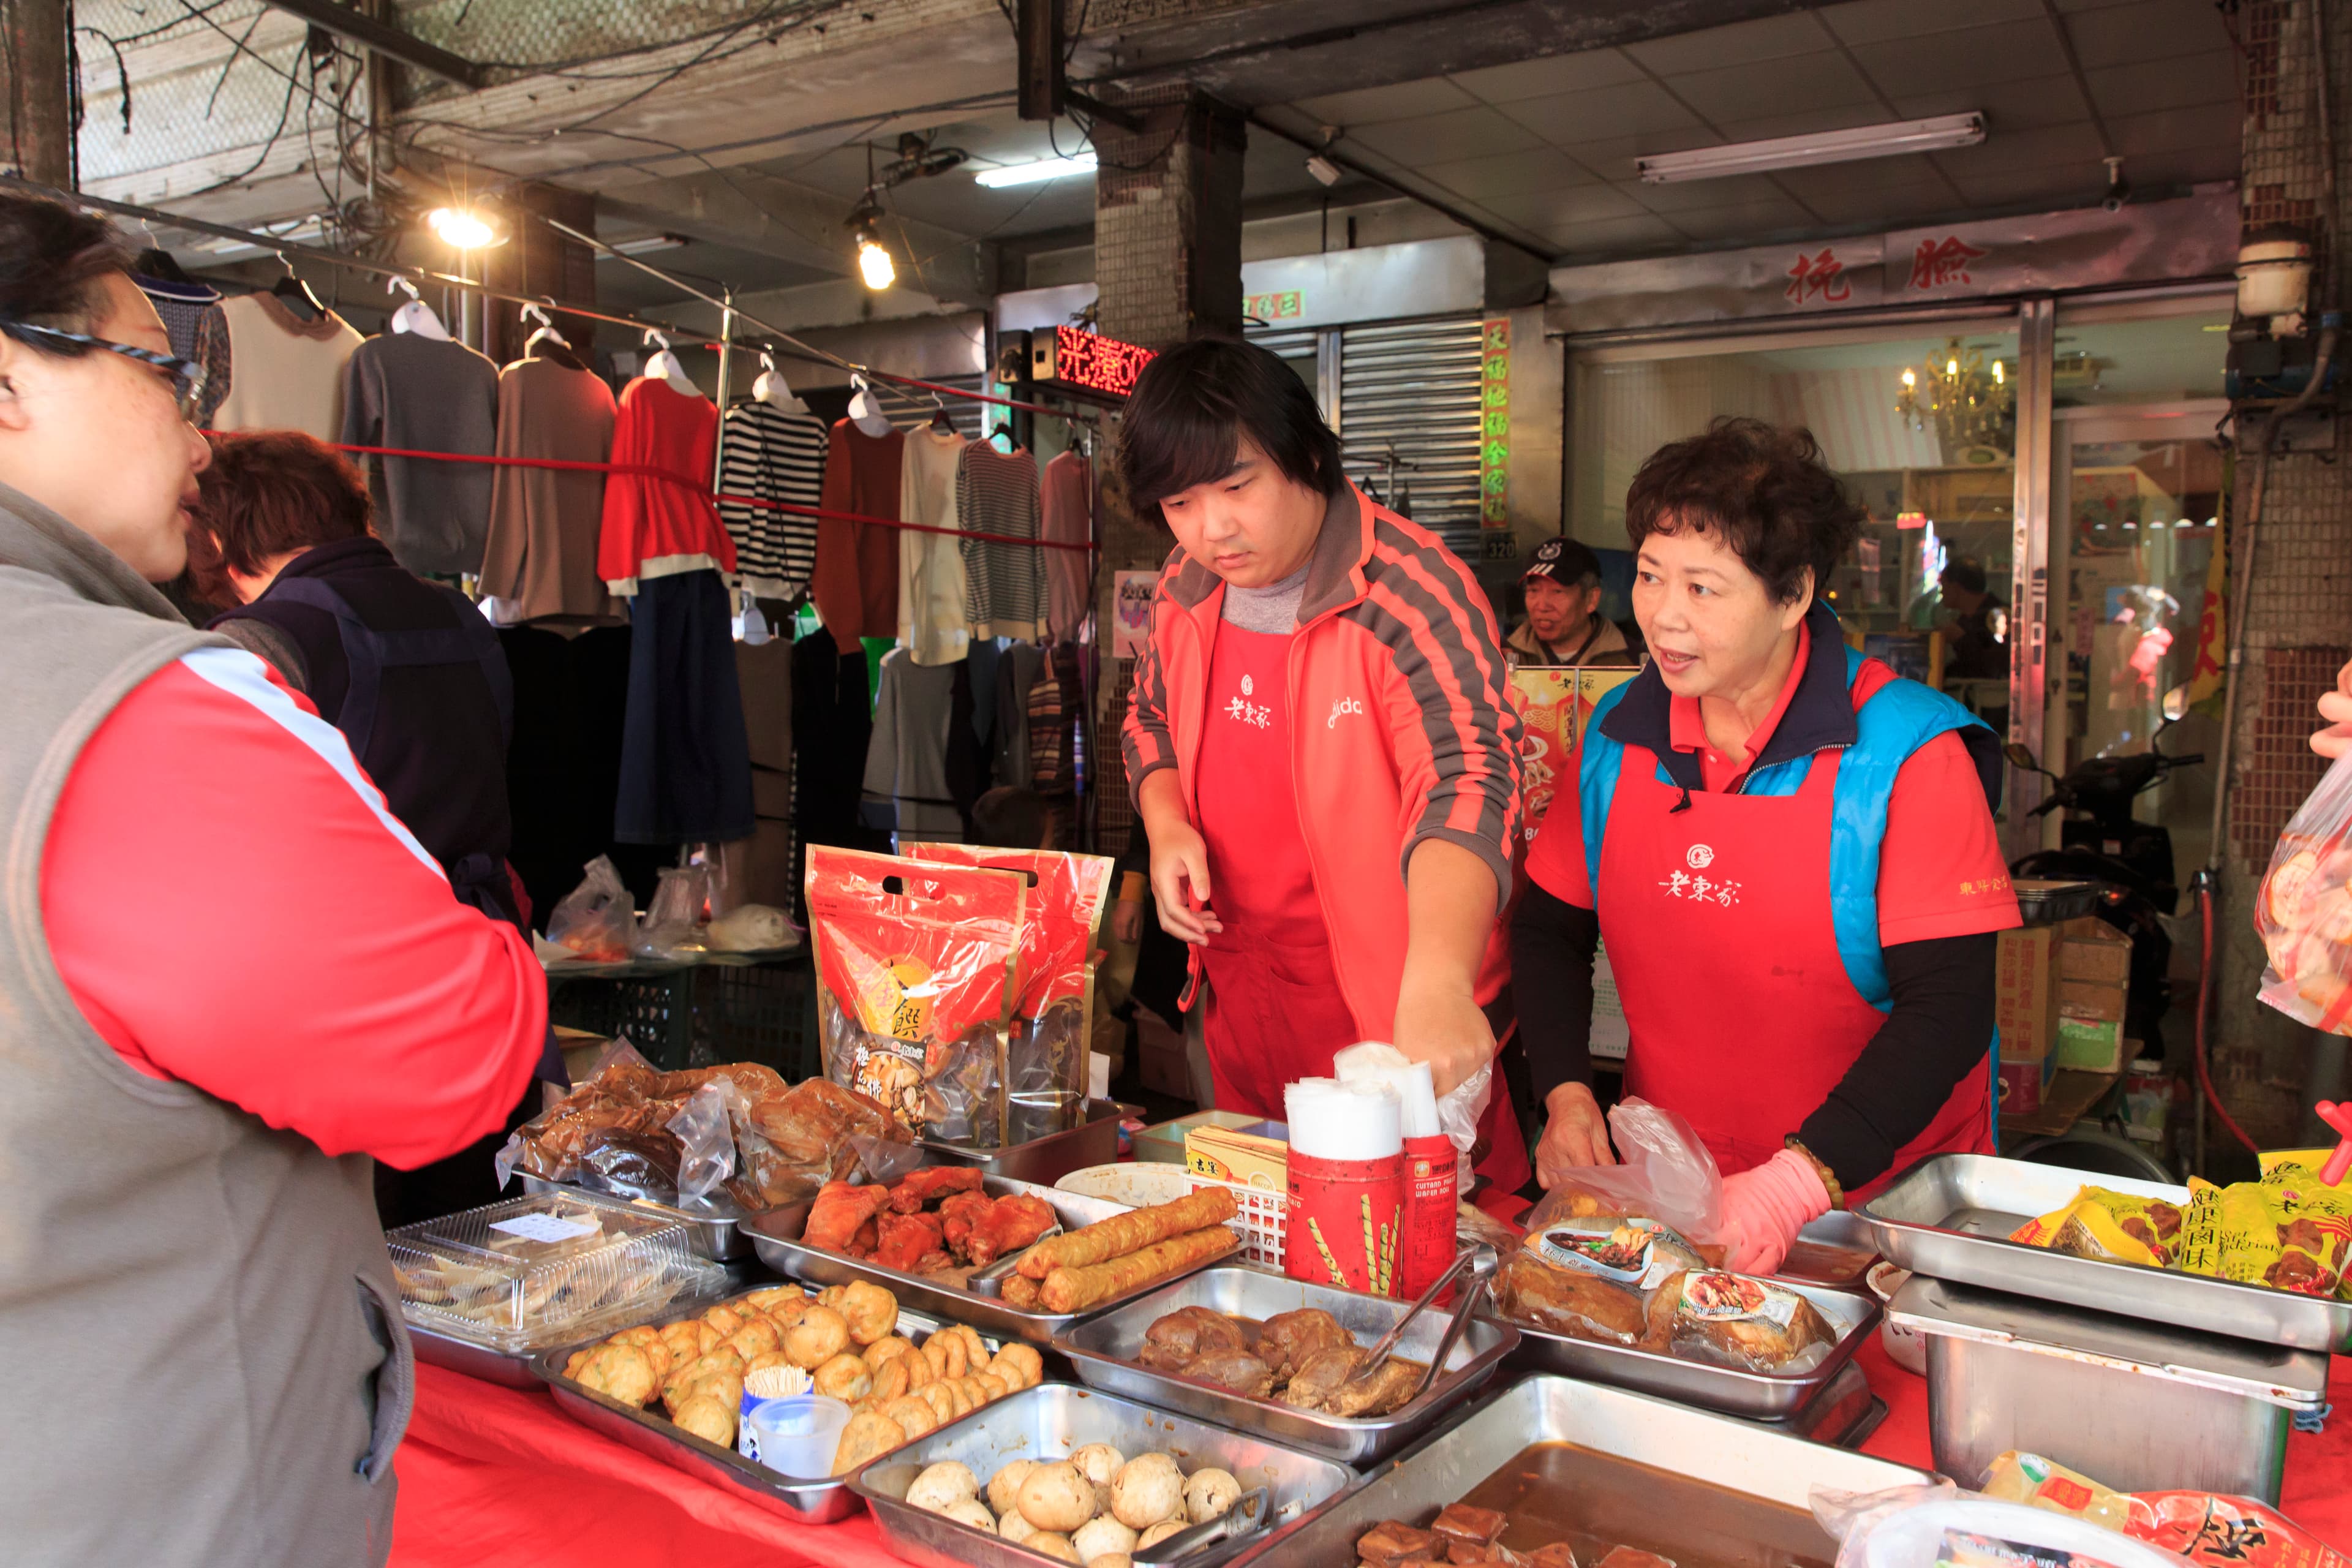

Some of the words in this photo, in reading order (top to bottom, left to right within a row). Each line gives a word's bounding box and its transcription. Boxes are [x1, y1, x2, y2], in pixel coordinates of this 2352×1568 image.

[1785, 235, 1991, 306] 挽臉
[1489, 542, 1515, 559] 320
[1224, 696, 1272, 729] 老東家
[1657, 869, 1742, 908] 老東家
